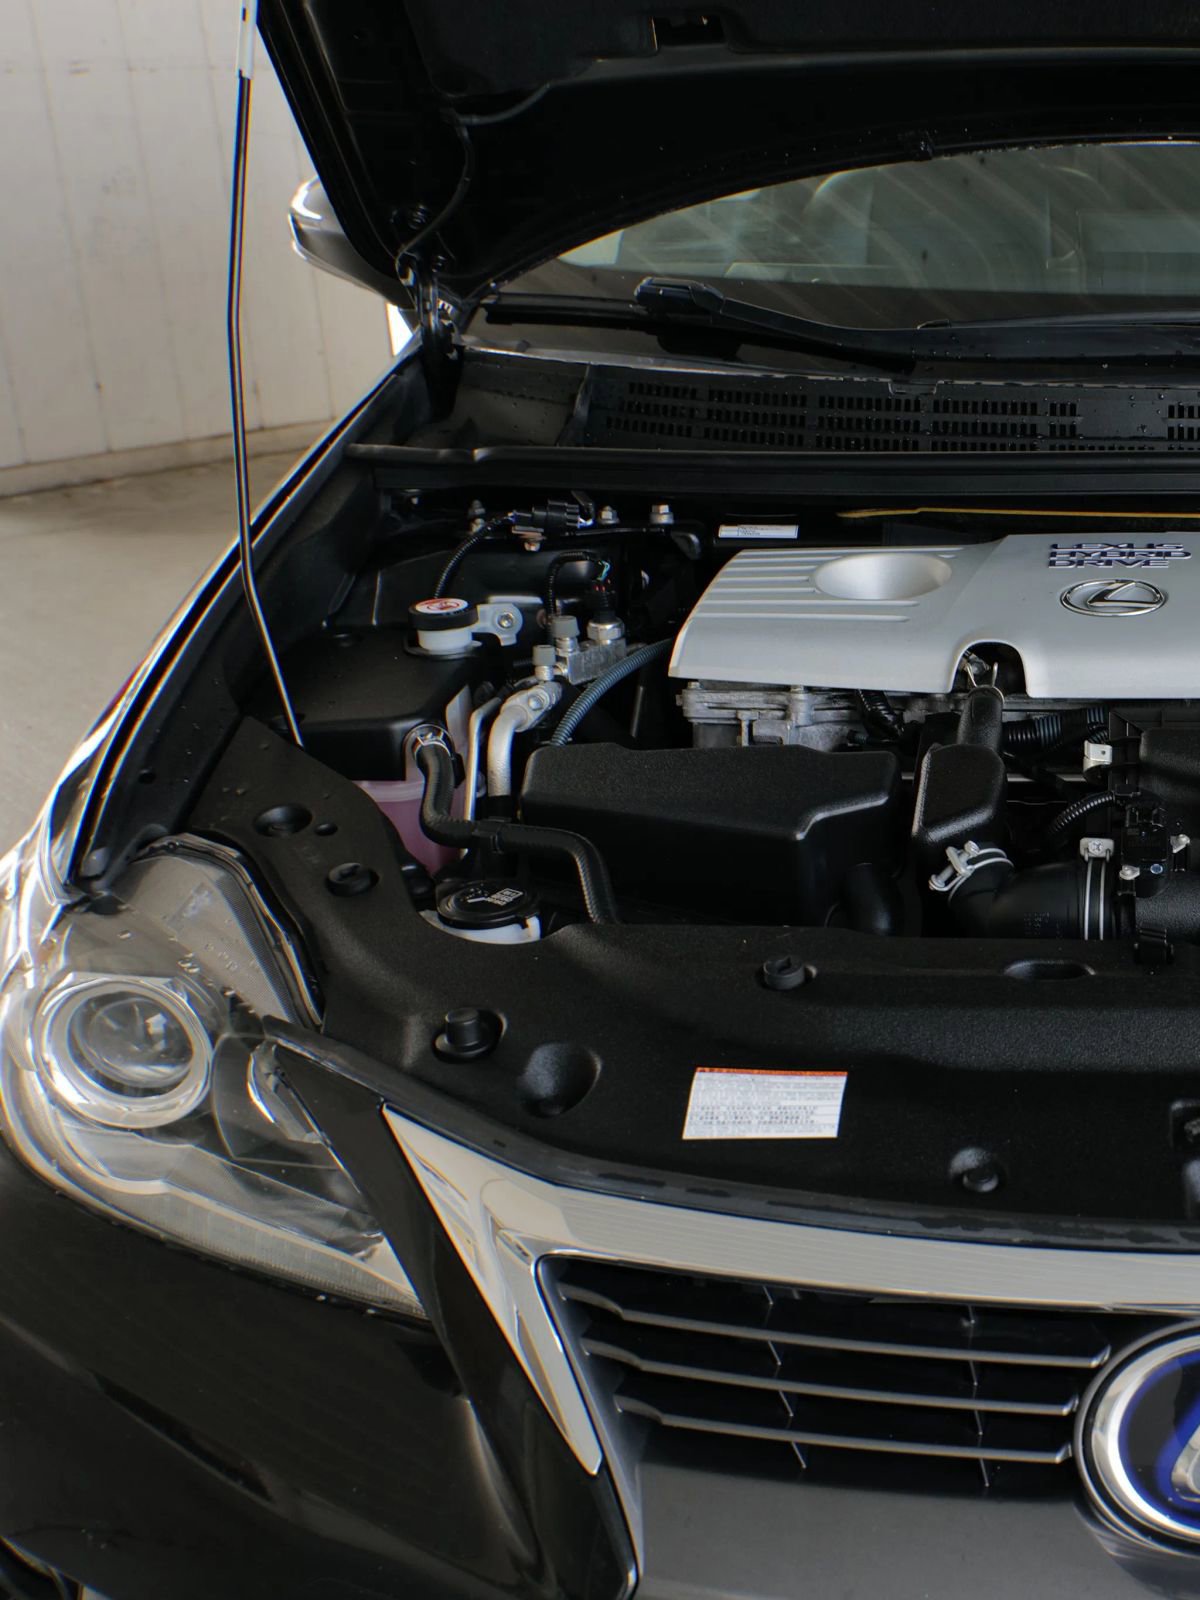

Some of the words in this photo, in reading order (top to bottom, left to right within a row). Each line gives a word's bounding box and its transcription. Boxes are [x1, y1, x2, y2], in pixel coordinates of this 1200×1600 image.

[1050, 543, 1184, 551] LEXUS
[1049, 551, 1192, 560] HYBRID
[1048, 559, 1170, 569] DRIVE
